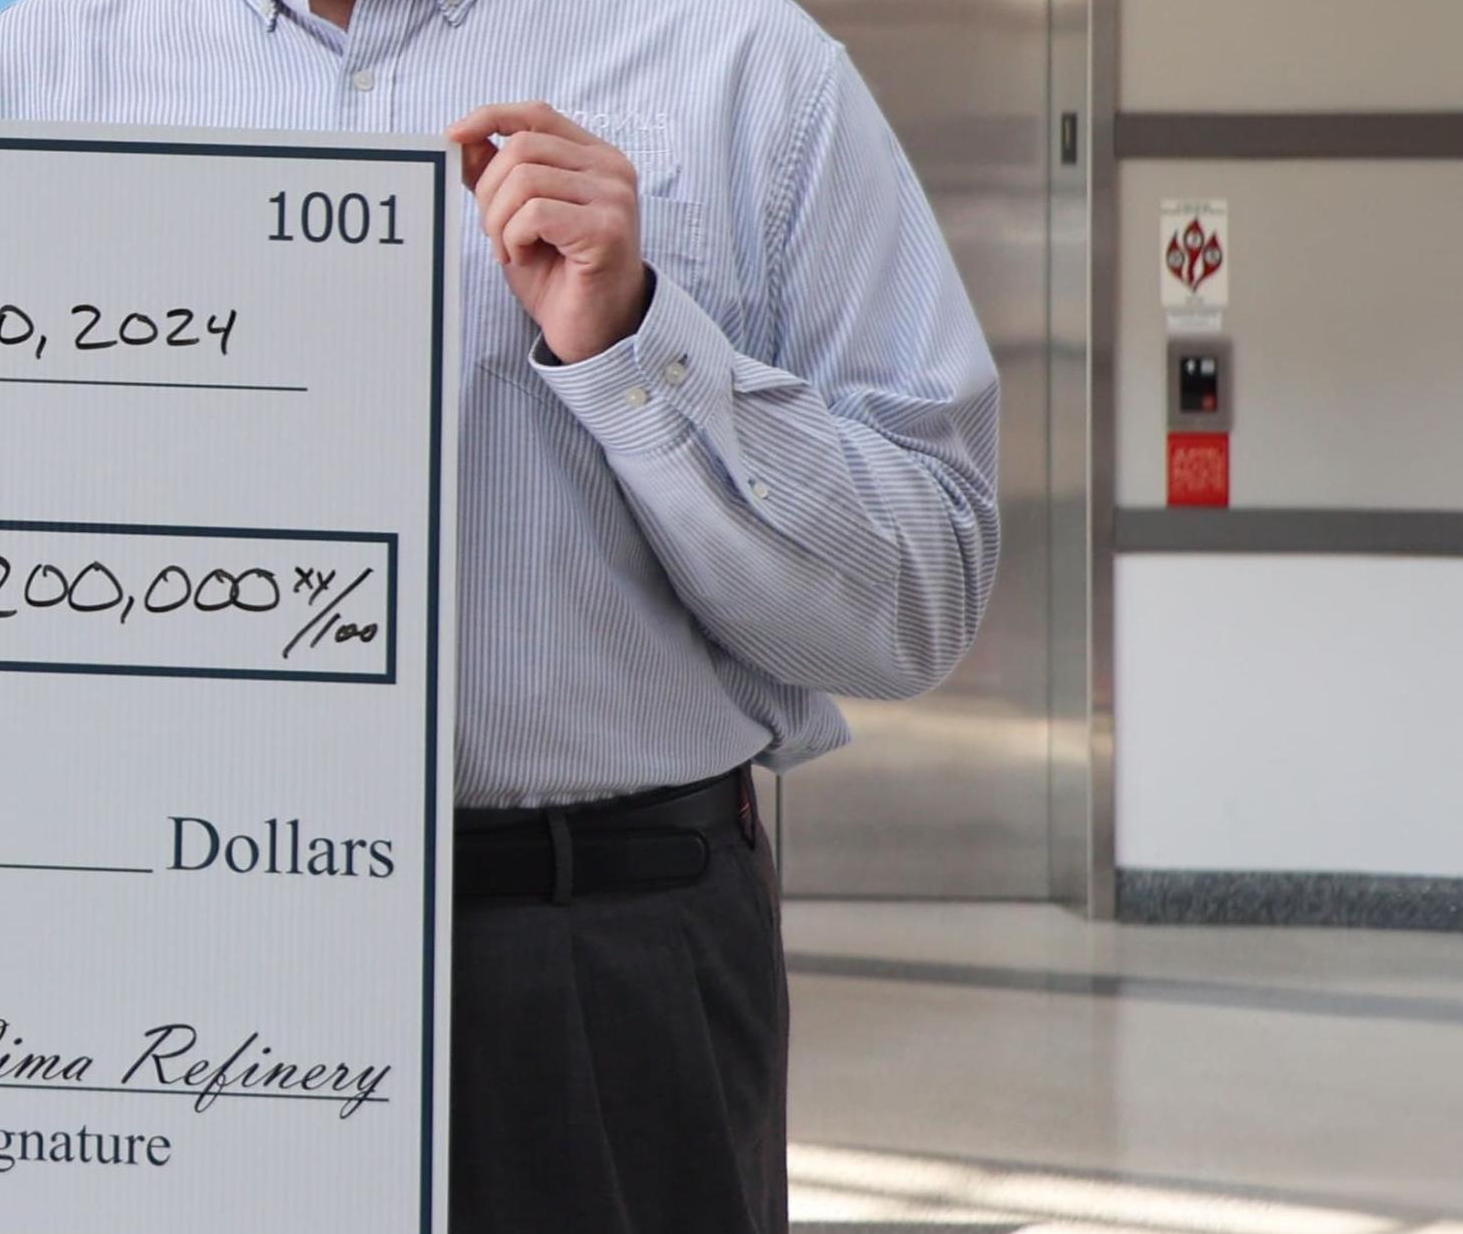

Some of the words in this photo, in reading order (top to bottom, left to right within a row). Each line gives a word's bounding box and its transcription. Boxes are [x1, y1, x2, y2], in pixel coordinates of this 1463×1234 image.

[269, 191, 403, 244] 1001
[72, 305, 236, 355] 2024
[168, 817, 394, 878] Dollars
[121, 1023, 391, 1119] Refinery
